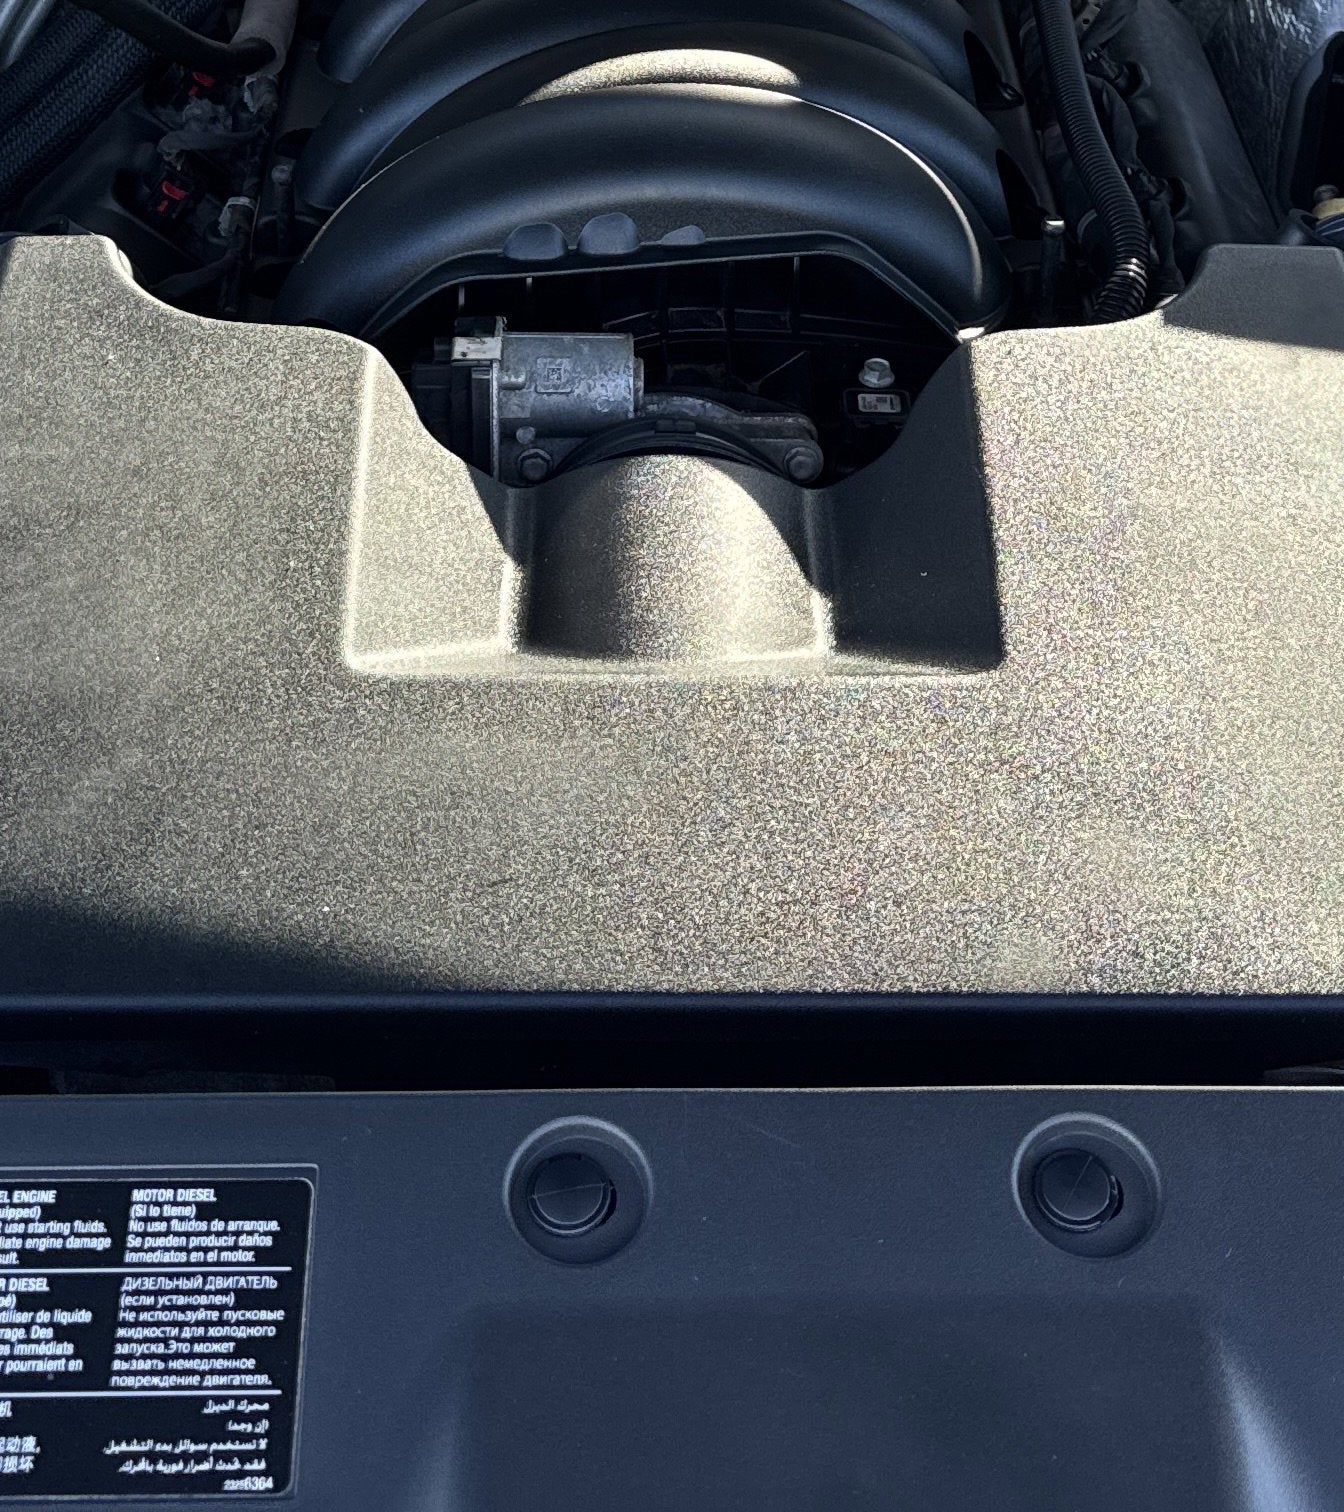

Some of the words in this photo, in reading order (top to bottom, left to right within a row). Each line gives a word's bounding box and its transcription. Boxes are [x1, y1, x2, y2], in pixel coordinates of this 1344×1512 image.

[12, 1190, 57, 1203] ENGINE
[132, 1188, 175, 1202] MOTOR
[177, 1188, 217, 1202] DIESEL
[149, 1204, 160, 1216] lo
[162, 1204, 196, 1218] tiene)
[5, 1223, 25, 1233] use
[27, 1220, 71, 1235] starting
[73, 1220, 107, 1233] fluids.
[128, 1219, 144, 1232] No
[147, 1221, 167, 1231] use
[170, 1219, 207, 1232] fluidos
[210, 1219, 225, 1231] de
[227, 1220, 280, 1233] arranque.
[25, 1236, 63, 1252] engine
[66, 1236, 111, 1251] damage
[127, 1235, 142, 1248] Se
[144, 1234, 186, 1249] pueden
[189, 1233, 236, 1249] producir
[238, 1233, 273, 1247] daños
[124, 1249, 187, 1263] inmediatos
[189, 1251, 204, 1262] en
[207, 1249, 218, 1262] el
[220, 1250, 255, 1262] motor.
[8, 1277, 50, 1292] DIESEL
[120, 1275, 203, 1292] ДИЗЕЛЬНЫЙ
[205, 1276, 278, 1291] ДВИГАТЕЛЬ
[119, 1292, 155, 1308] (если
[157, 1291, 235, 1309] установлен)
[36, 1310, 51, 1323] de
[54, 1309, 92, 1325] liquide
[118, 1309, 136, 1323] Не
[139, 1308, 220, 1324] используйте
[222, 1309, 285, 1323] пусковые
[30, 1325, 54, 1339] Des
[115, 1326, 179, 1339] жидкости
[181, 1326, 205, 1339] для
[206, 1325, 276, 1339] холодного
[13, 1341, 74, 1356] immédiats
[193, 1341, 236, 1354] может
[6, 1357, 66, 1375] pourraient
[68, 1359, 83, 1372] en
[111, 1358, 165, 1371] вызвать
[168, 1357, 256, 1371] немедленное
[111, 1374, 201, 1388] повреждение
[202, 1374, 273, 1387] двигателя.
[236, 1399, 270, 1413] محرك
